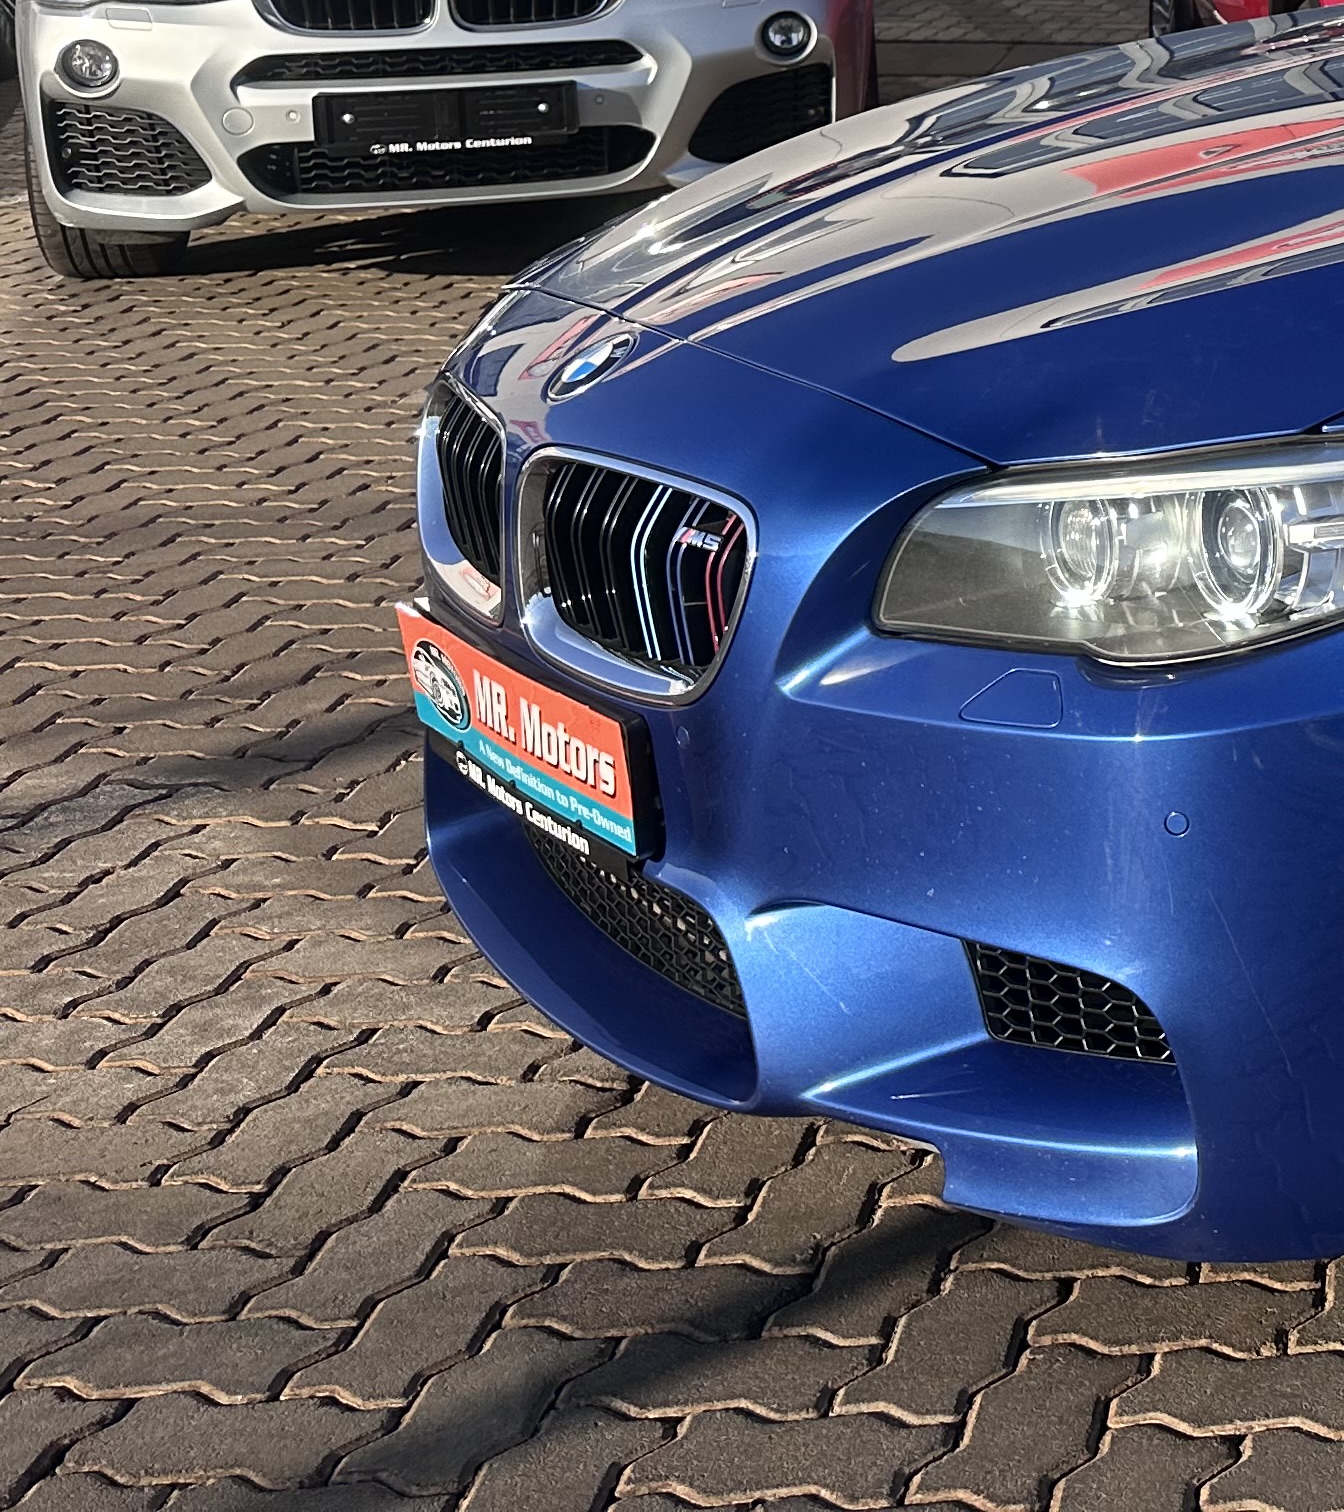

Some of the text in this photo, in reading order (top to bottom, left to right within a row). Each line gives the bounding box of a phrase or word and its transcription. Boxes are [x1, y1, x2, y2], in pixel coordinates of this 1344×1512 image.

[416, 140, 462, 152] Motors
[465, 136, 533, 149] Centurion
[680, 527, 722, 552] M5
[473, 669, 617, 799] MR. Motors
[487, 776, 524, 816] Motors
[525, 803, 590, 856] Centurion
[506, 759, 555, 802] Definition
[556, 788, 569, 808] to
[570, 796, 632, 843] Pre-Owned
